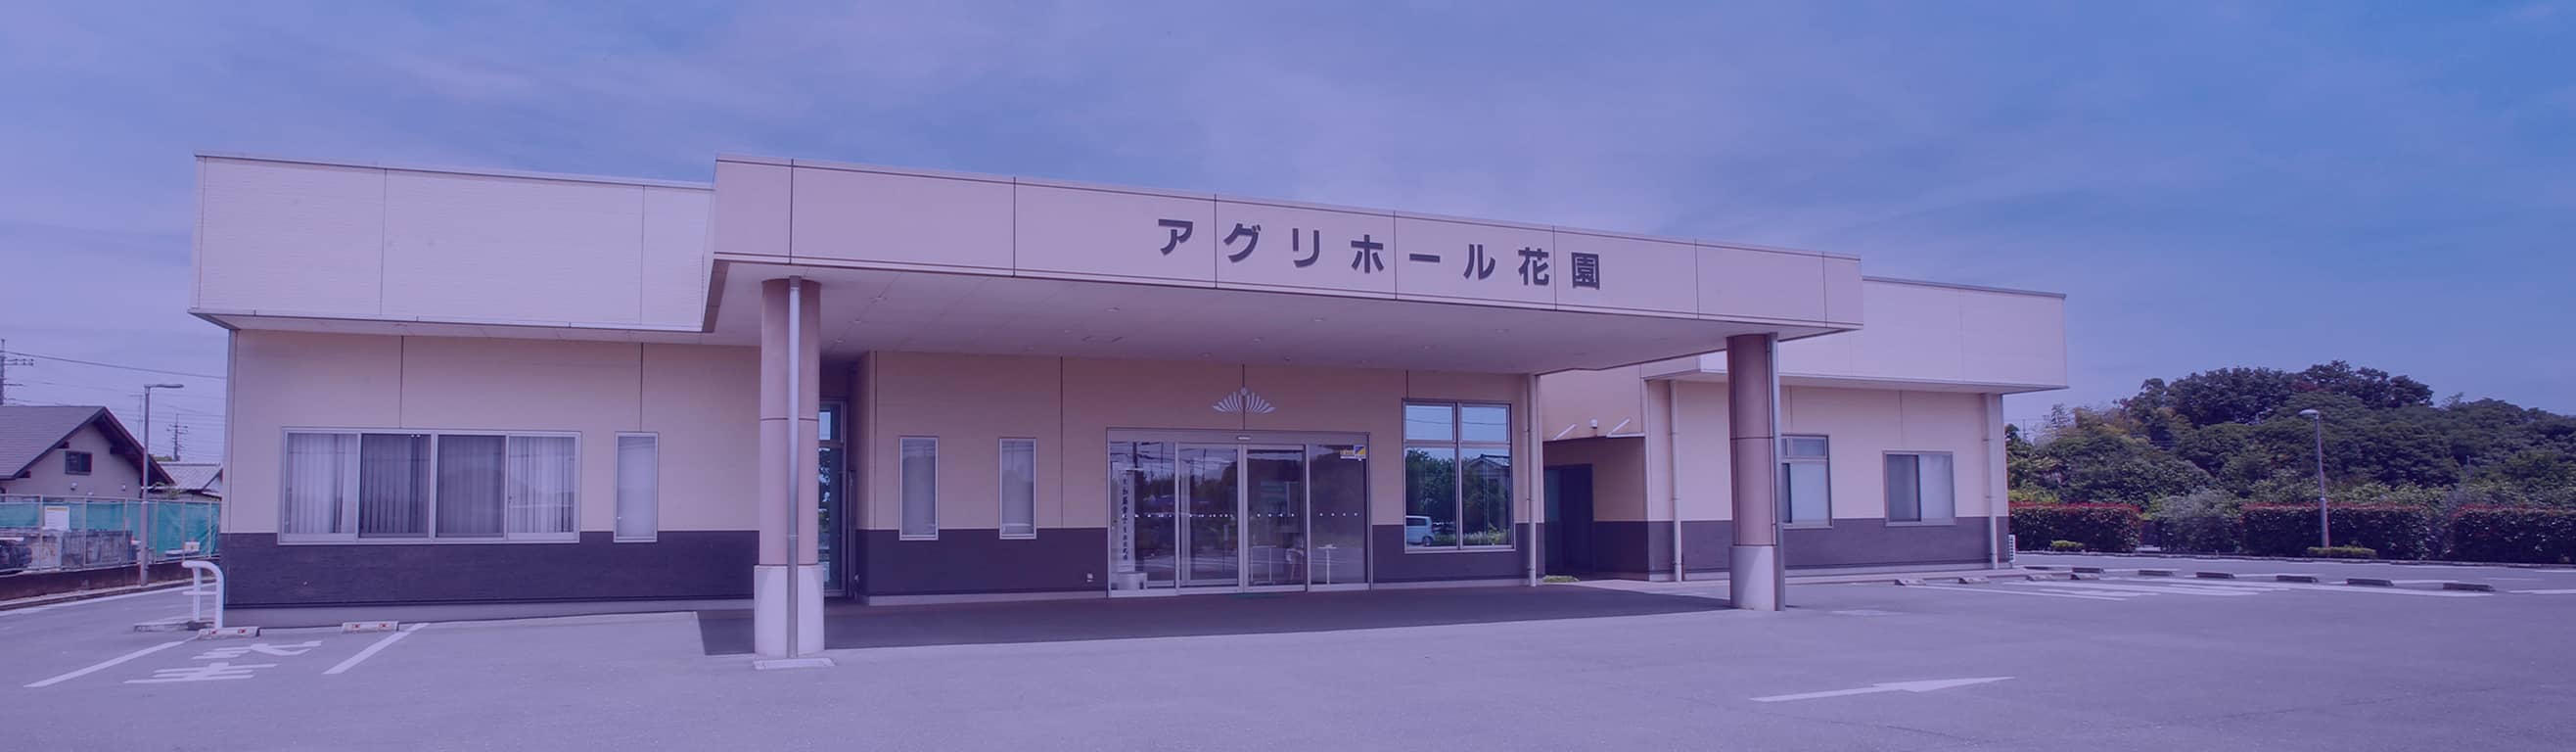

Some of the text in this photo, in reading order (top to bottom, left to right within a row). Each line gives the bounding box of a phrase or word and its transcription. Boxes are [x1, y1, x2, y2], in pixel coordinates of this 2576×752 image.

[1157, 217, 1601, 291] アグリホール花園
